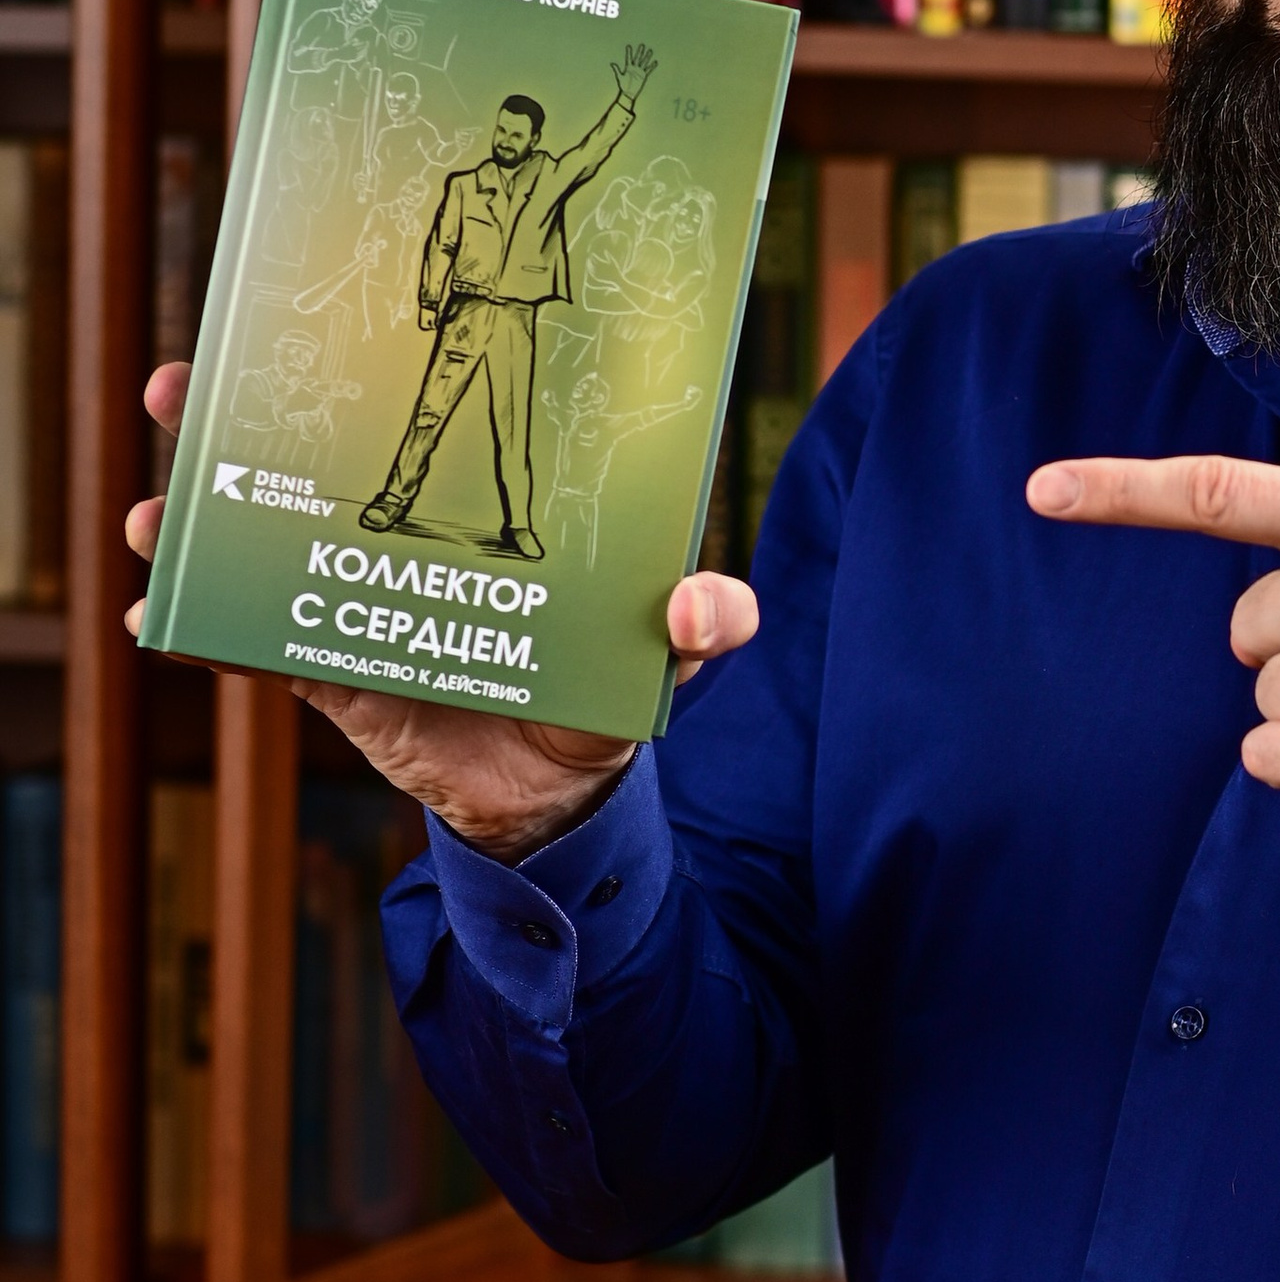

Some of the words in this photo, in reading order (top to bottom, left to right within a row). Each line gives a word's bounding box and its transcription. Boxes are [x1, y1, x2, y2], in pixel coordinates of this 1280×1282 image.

[673, 97, 711, 123] 18+
[251, 488, 335, 517] KORNEV
[254, 470, 315, 495] DENIS
[307, 541, 548, 617] КОЛЛЕКТОР
[291, 593, 325, 628] С
[334, 601, 540, 672] СЕРДЦЕМ.
[285, 642, 415, 682] РУКОВОДСТВО
[418, 669, 433, 685] К
[432, 674, 531, 705] ДЕЙСТВИЮ
